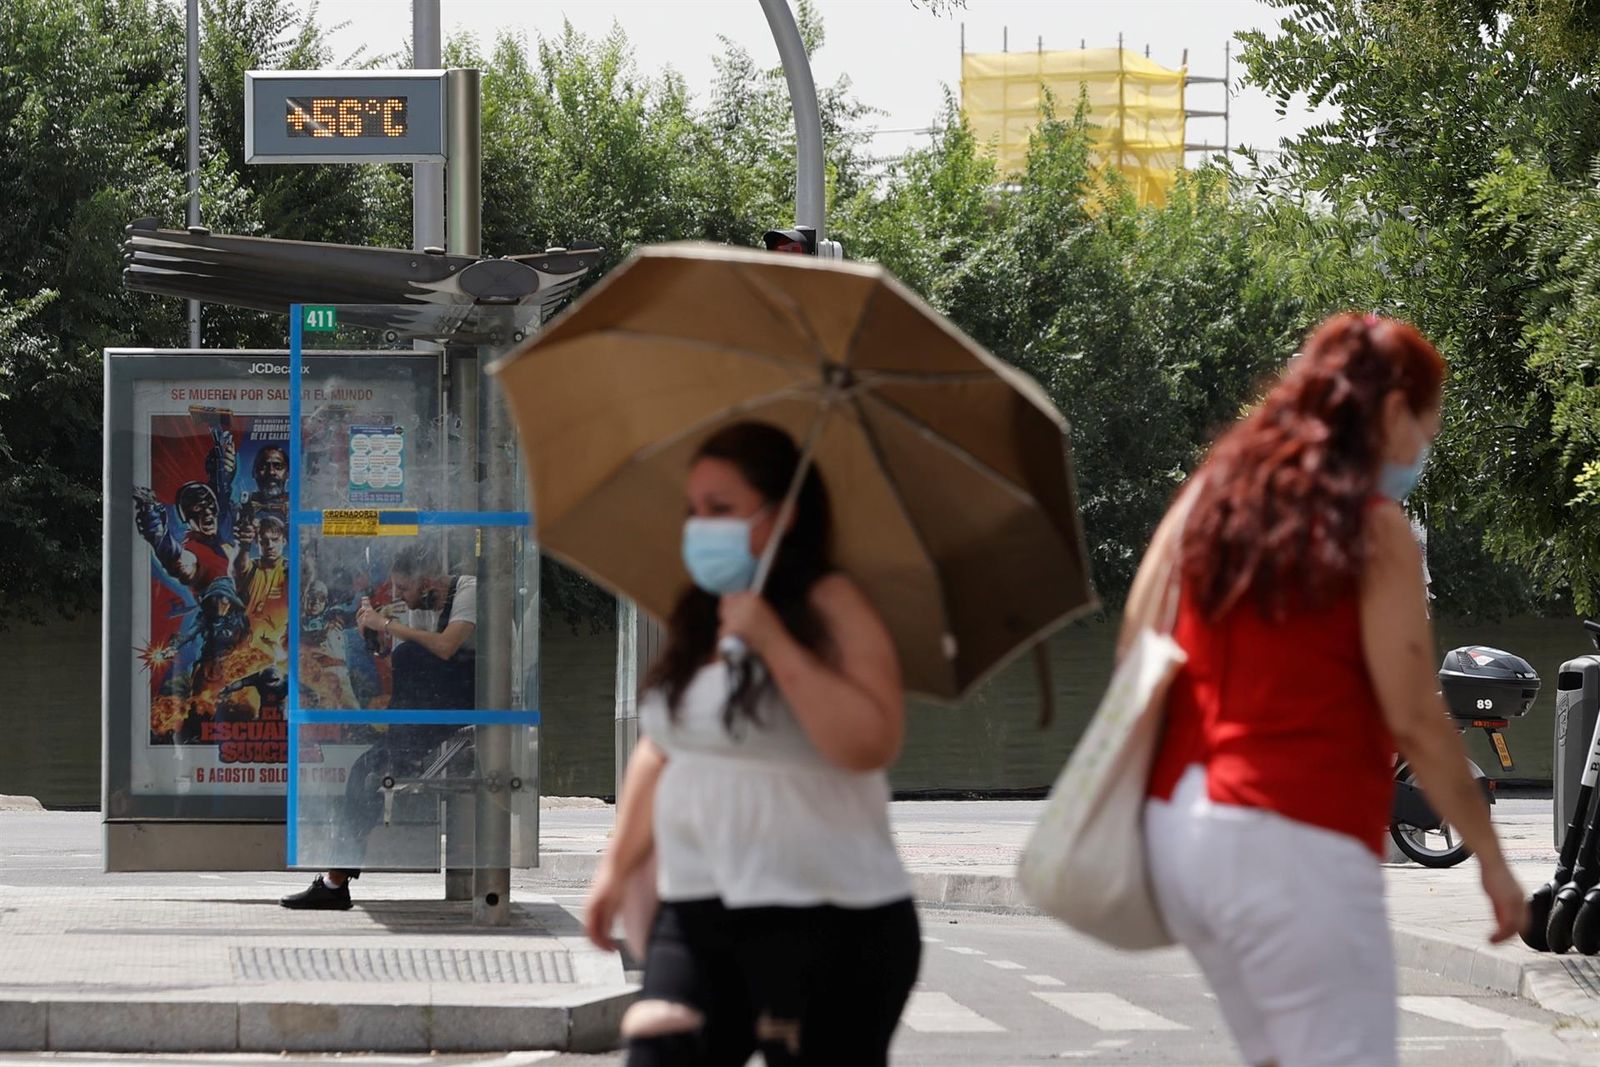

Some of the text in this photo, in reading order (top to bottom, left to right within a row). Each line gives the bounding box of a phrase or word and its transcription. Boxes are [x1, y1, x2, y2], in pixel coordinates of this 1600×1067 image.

[287, 99, 403, 138] +56°C
[306, 310, 333, 327] 411
[248, 363, 310, 374] JCDecx
[171, 388, 186, 400] SE
[188, 388, 237, 400] MUEREN
[240, 388, 264, 400] POR
[314, 388, 328, 401] EL
[331, 388, 373, 401] MUNDO
[1476, 699, 1493, 710] 89
[196, 768, 204, 783] 6
[209, 768, 255, 783] AGOSTO
[260, 768, 288, 783] SOLO
